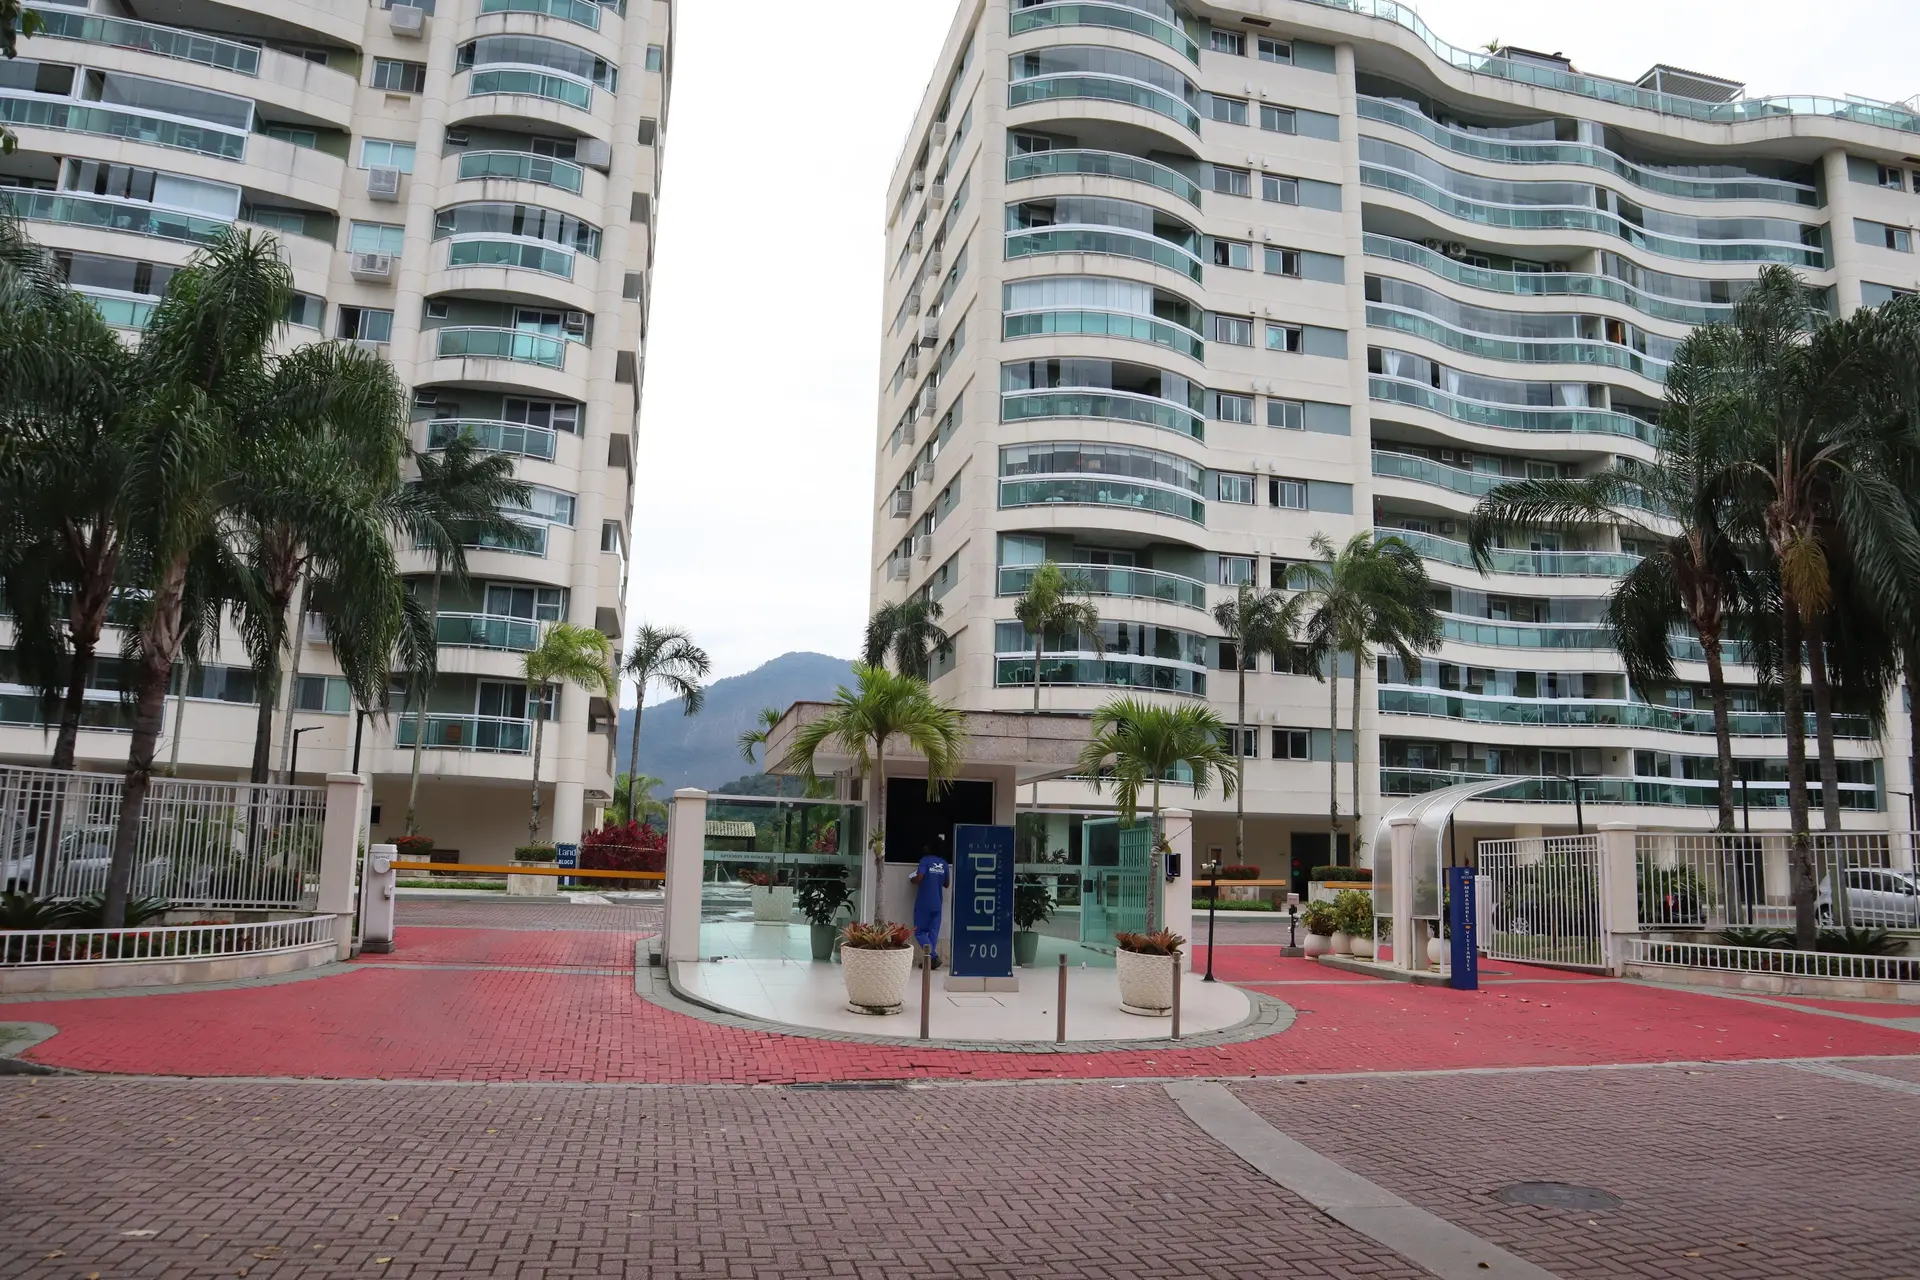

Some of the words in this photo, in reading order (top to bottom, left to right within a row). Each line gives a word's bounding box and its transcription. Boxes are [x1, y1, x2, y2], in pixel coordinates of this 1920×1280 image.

[559, 848, 577, 856] Land
[967, 853, 997, 931] Land
[969, 944, 998, 958] 700
